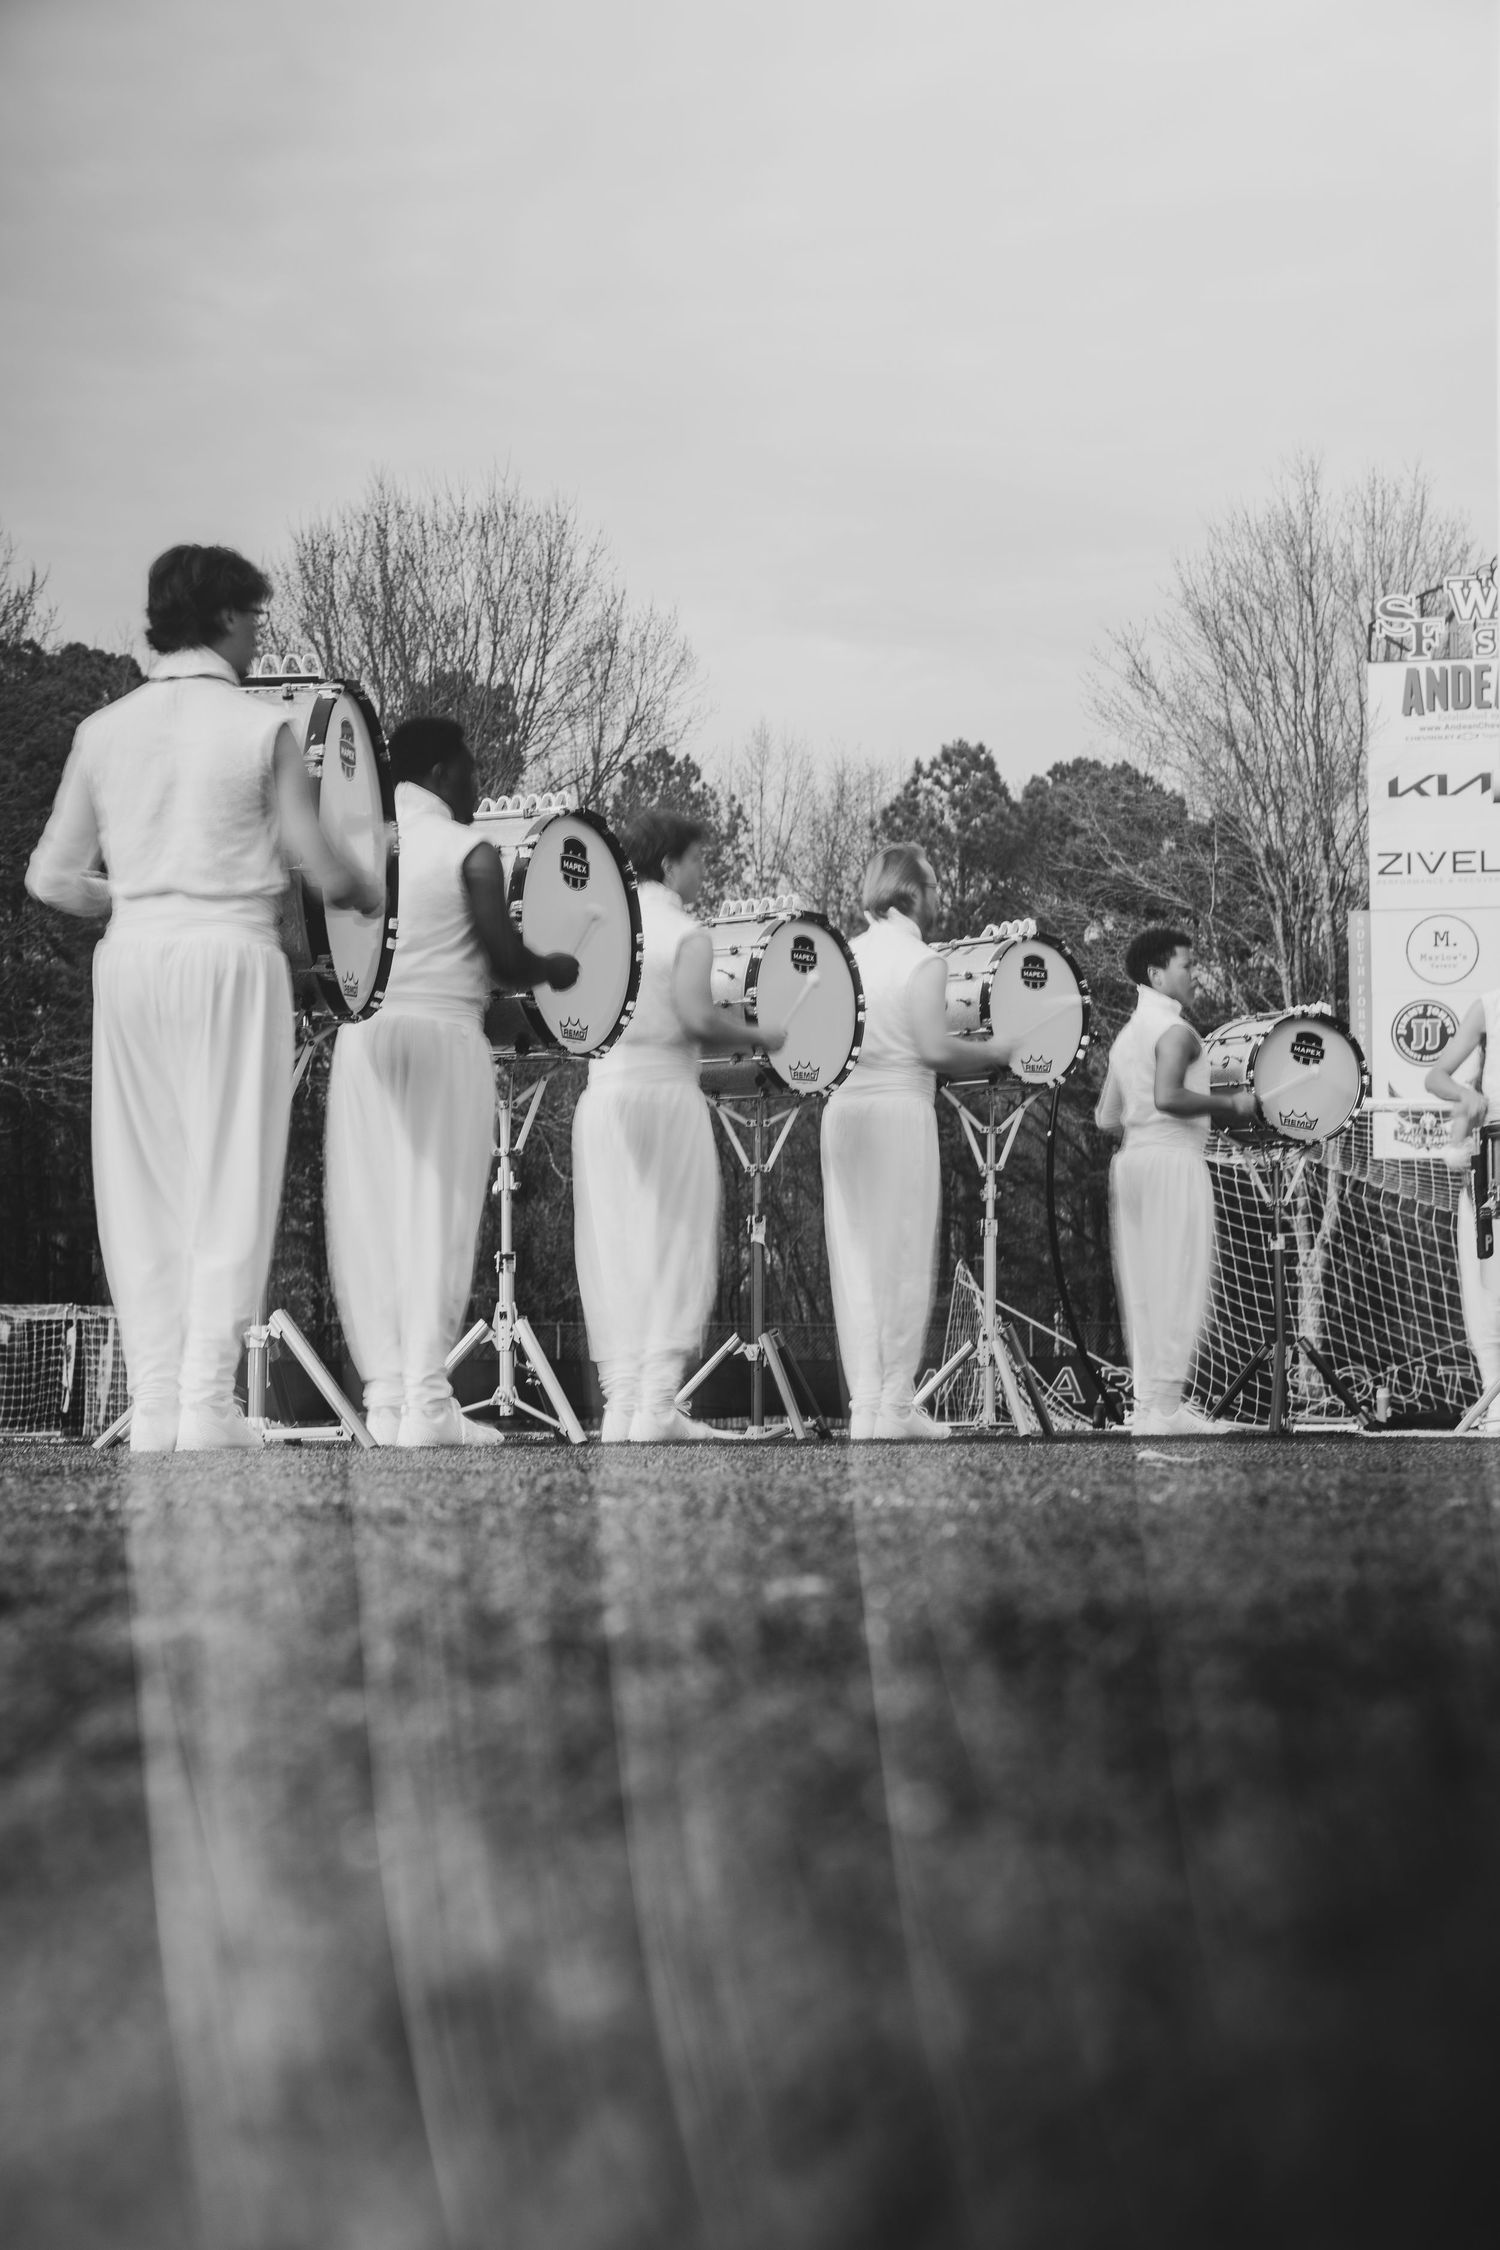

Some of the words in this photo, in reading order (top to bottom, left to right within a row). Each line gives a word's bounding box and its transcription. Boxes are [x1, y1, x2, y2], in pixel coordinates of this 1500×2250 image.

[1402, 664, 1500, 717] ANDE
[1388, 772, 1491, 798] KIA
[562, 859, 588, 875] MAPEX
[1378, 851, 1500, 875] ZIVEL
[792, 952, 816, 963] MAPEX
[1022, 969, 1046, 979] MAPEX
[563, 1027, 586, 1039] REMO
[1411, 1019, 1442, 1050] JJ
[1293, 1045, 1322, 1057] MAPEX
[1025, 1064, 1050, 1073] REMO
[792, 1071, 817, 1081] REMO
[1283, 1117, 1314, 1129] REMO
